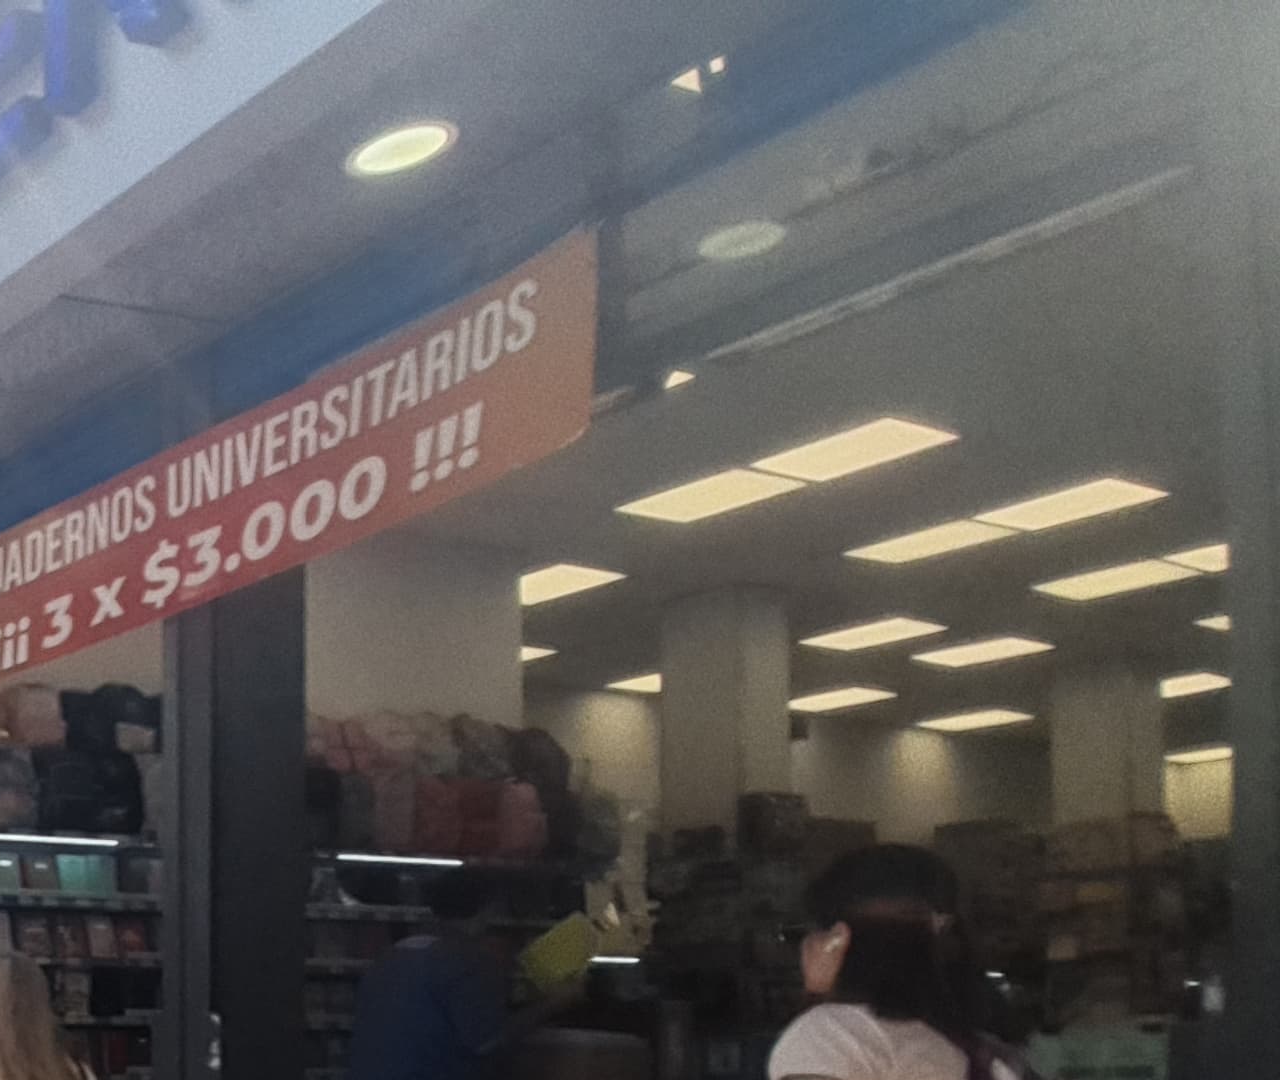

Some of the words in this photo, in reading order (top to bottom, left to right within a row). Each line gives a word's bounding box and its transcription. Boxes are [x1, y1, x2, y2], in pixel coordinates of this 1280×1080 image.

[166, 278, 539, 520] UNIVERSITARIOS
[42, 595, 74, 650] 3
[142, 455, 387, 609] $3.000
[409, 401, 484, 493] !!!
